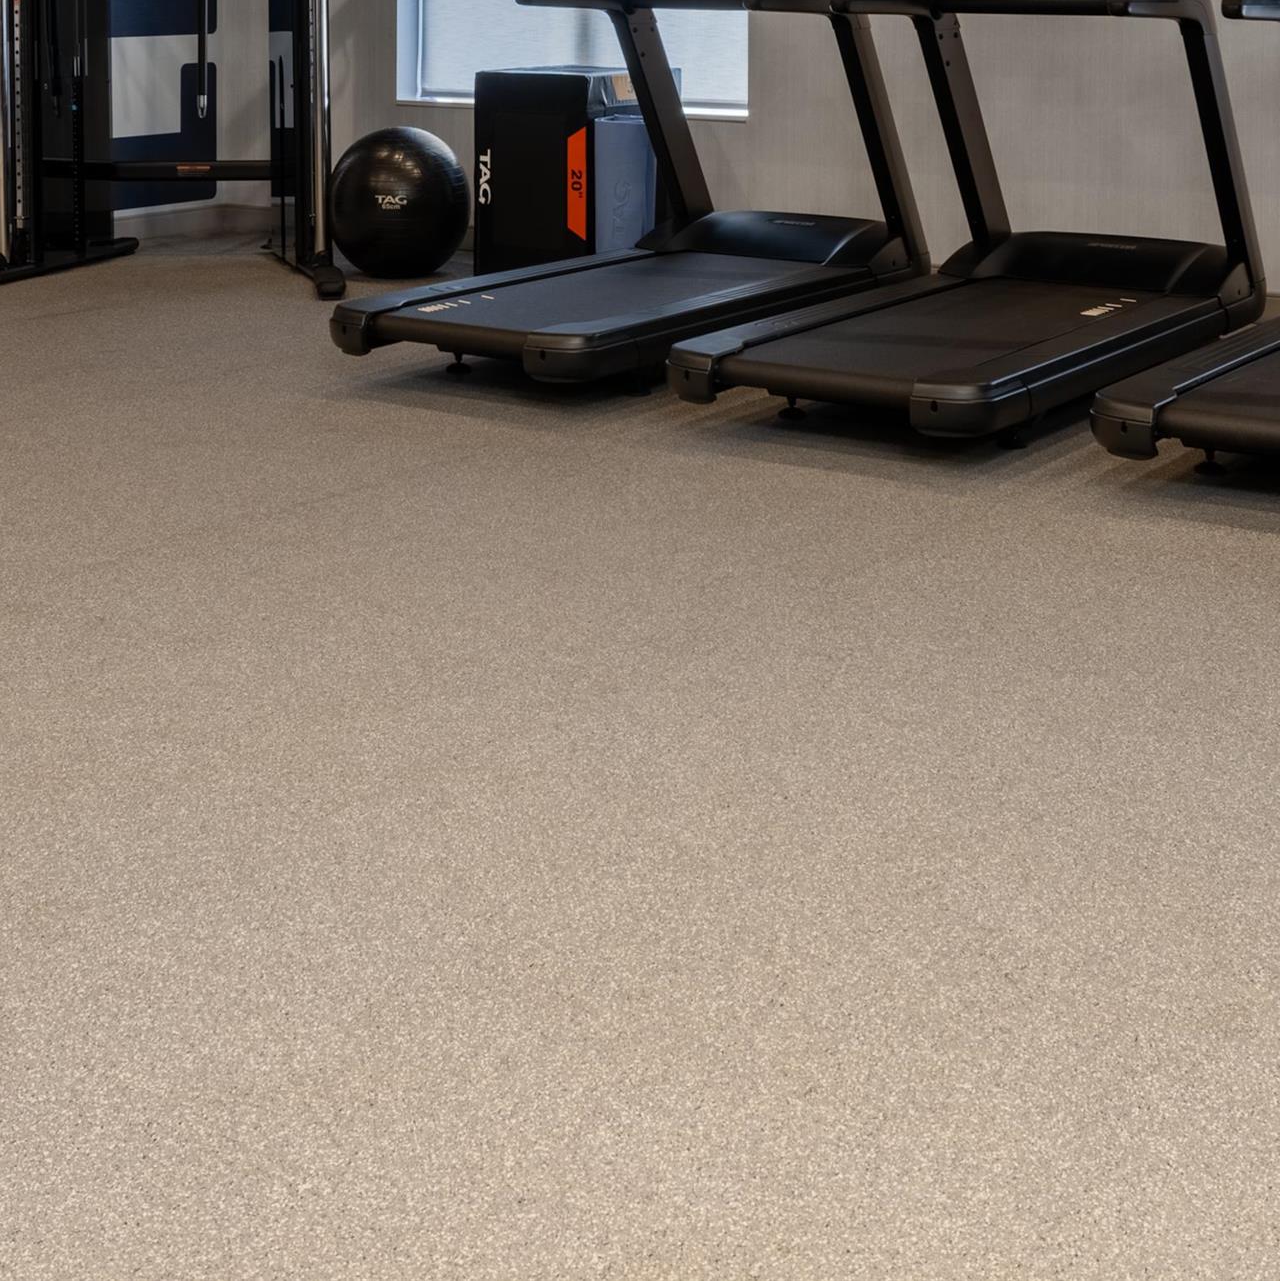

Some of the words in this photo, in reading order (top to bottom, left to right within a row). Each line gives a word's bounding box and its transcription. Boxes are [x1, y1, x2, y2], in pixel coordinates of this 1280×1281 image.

[478, 148, 492, 206] TAG
[571, 169, 584, 199] 20"
[374, 194, 408, 205] TAG
